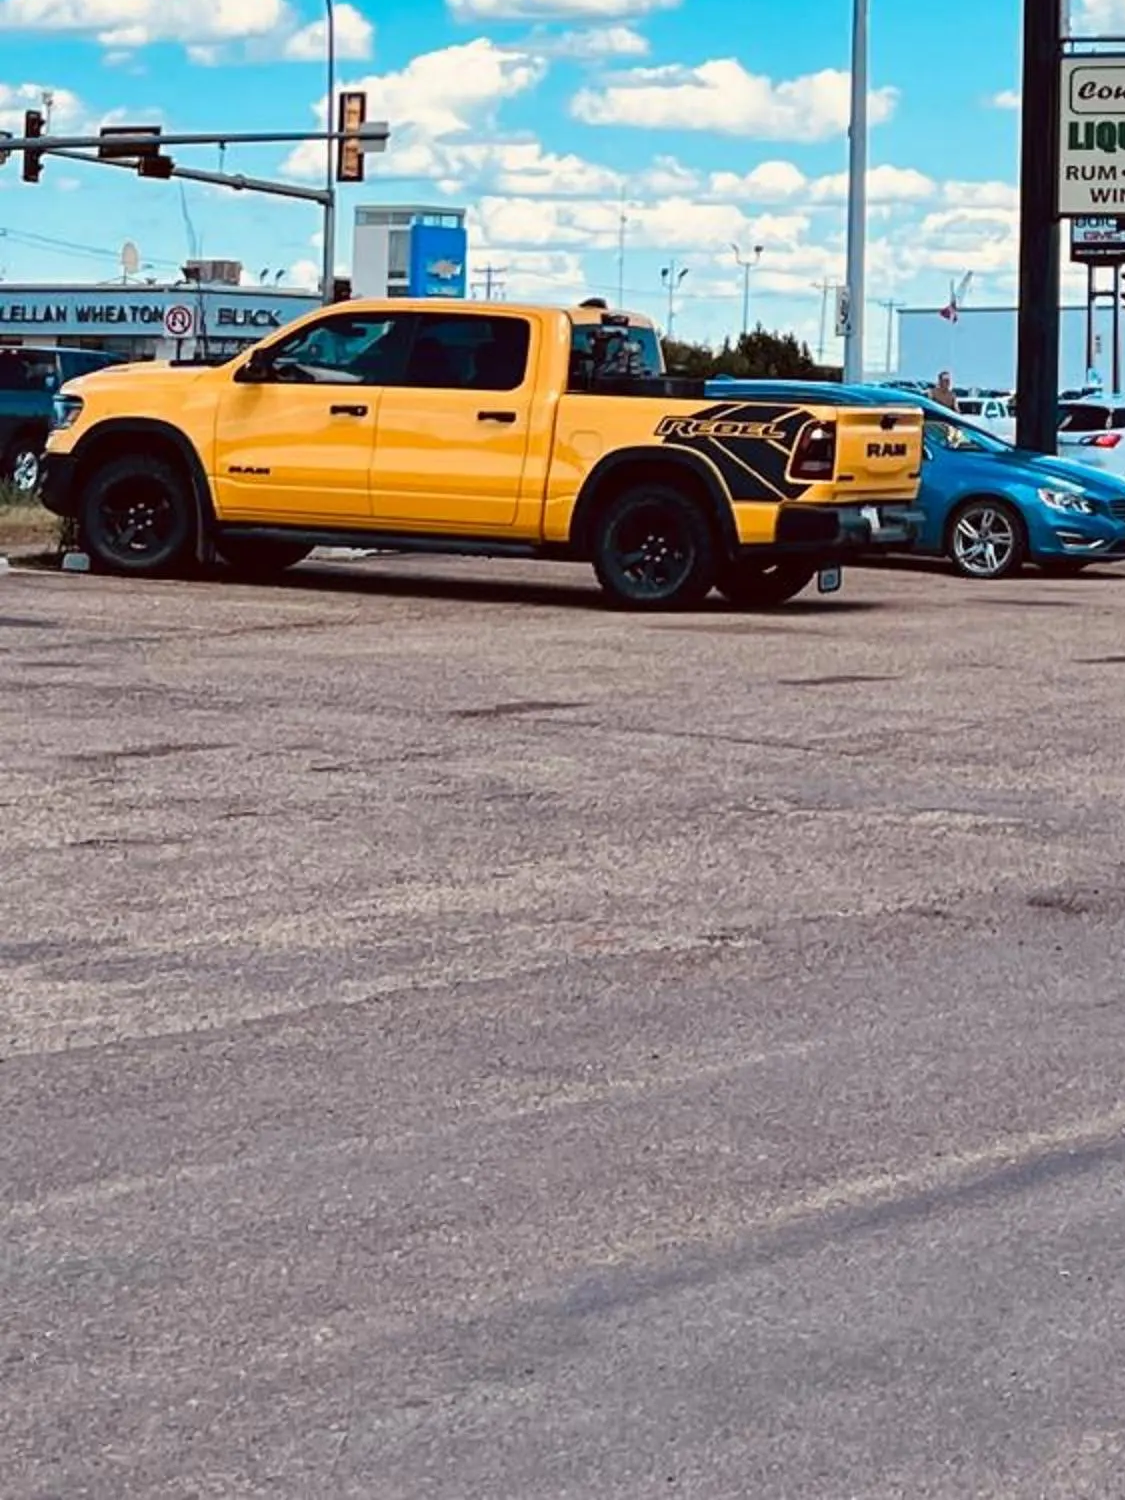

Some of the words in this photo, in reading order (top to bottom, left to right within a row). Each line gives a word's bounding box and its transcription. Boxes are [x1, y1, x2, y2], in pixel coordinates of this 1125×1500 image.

[1066, 165, 1117, 181] RUM
[75, 304, 164, 324] WHEATON
[216, 307, 282, 327] BUICK
[866, 443, 907, 458] RAM
